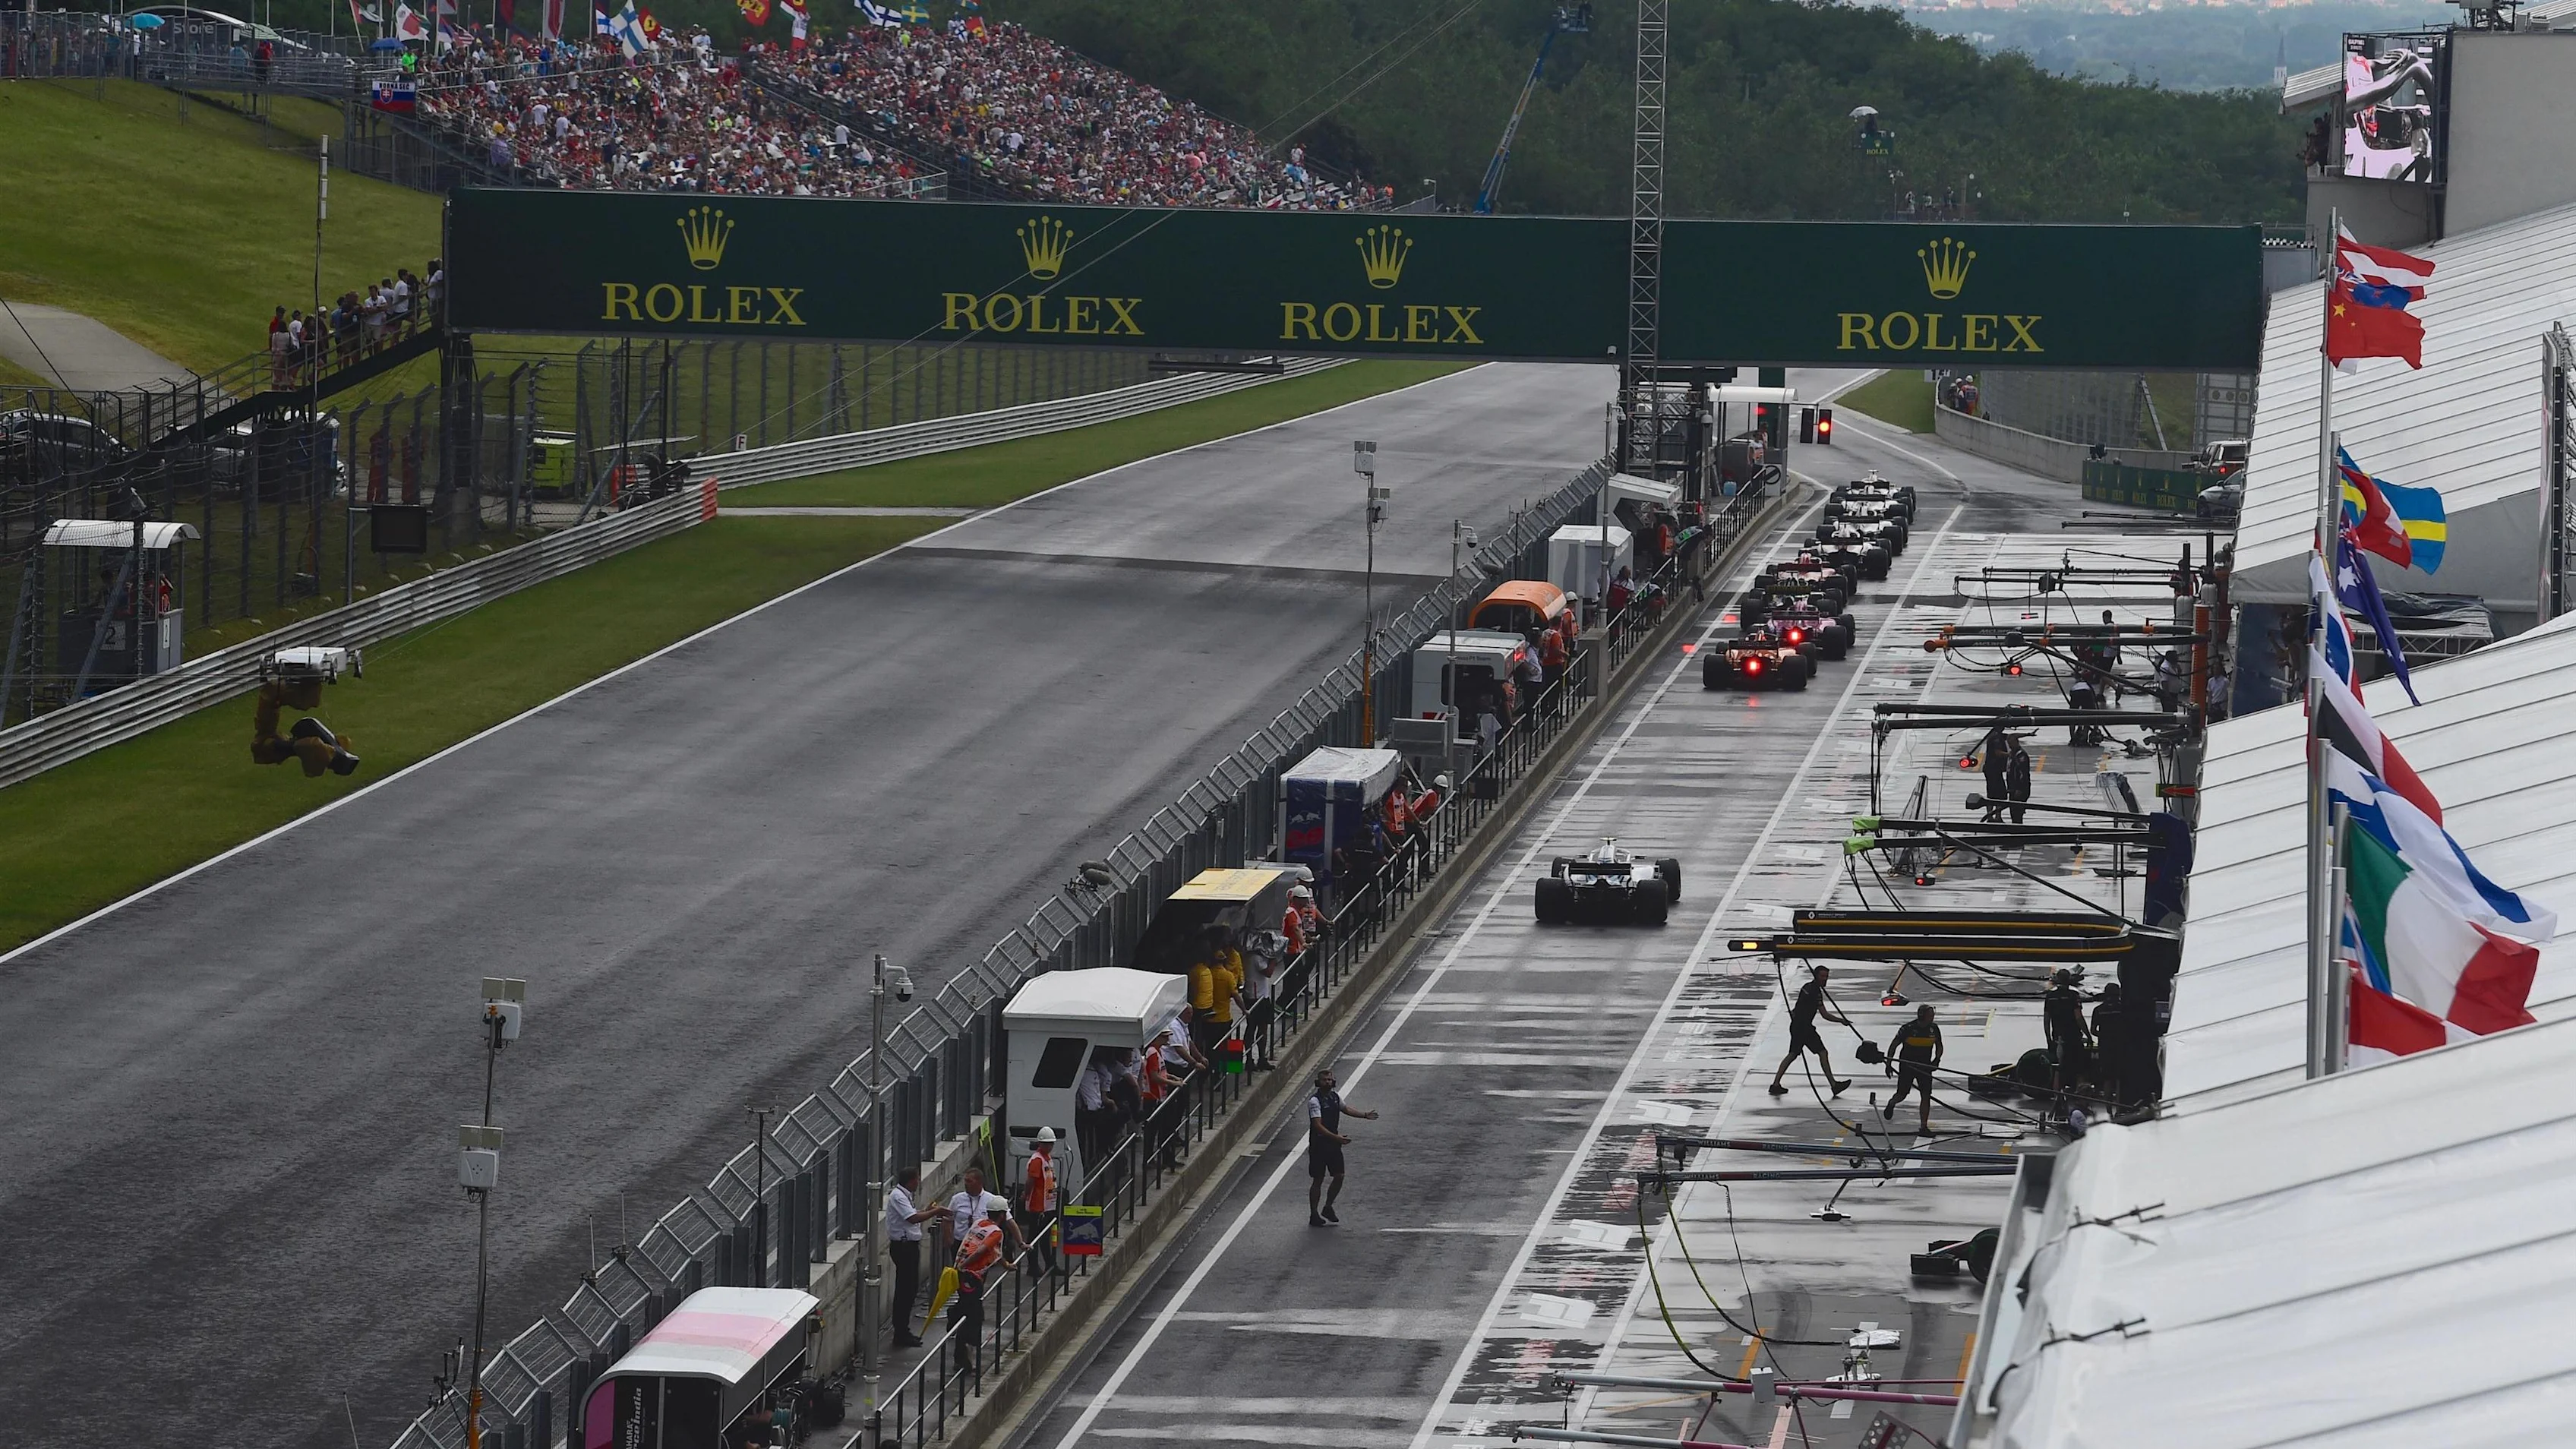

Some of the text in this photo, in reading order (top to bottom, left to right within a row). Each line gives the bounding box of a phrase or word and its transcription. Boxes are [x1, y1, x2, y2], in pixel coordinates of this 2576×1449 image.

[602, 283, 807, 326] ROLEX
[941, 293, 1144, 336] ROLEX
[1280, 301, 1484, 345] ROLEX
[1836, 312, 2044, 353] ROLEX
[738, 436, 745, 449] F
[105, 627, 116, 645] 2
[1697, 1139, 1731, 1148] WILLIAMS
